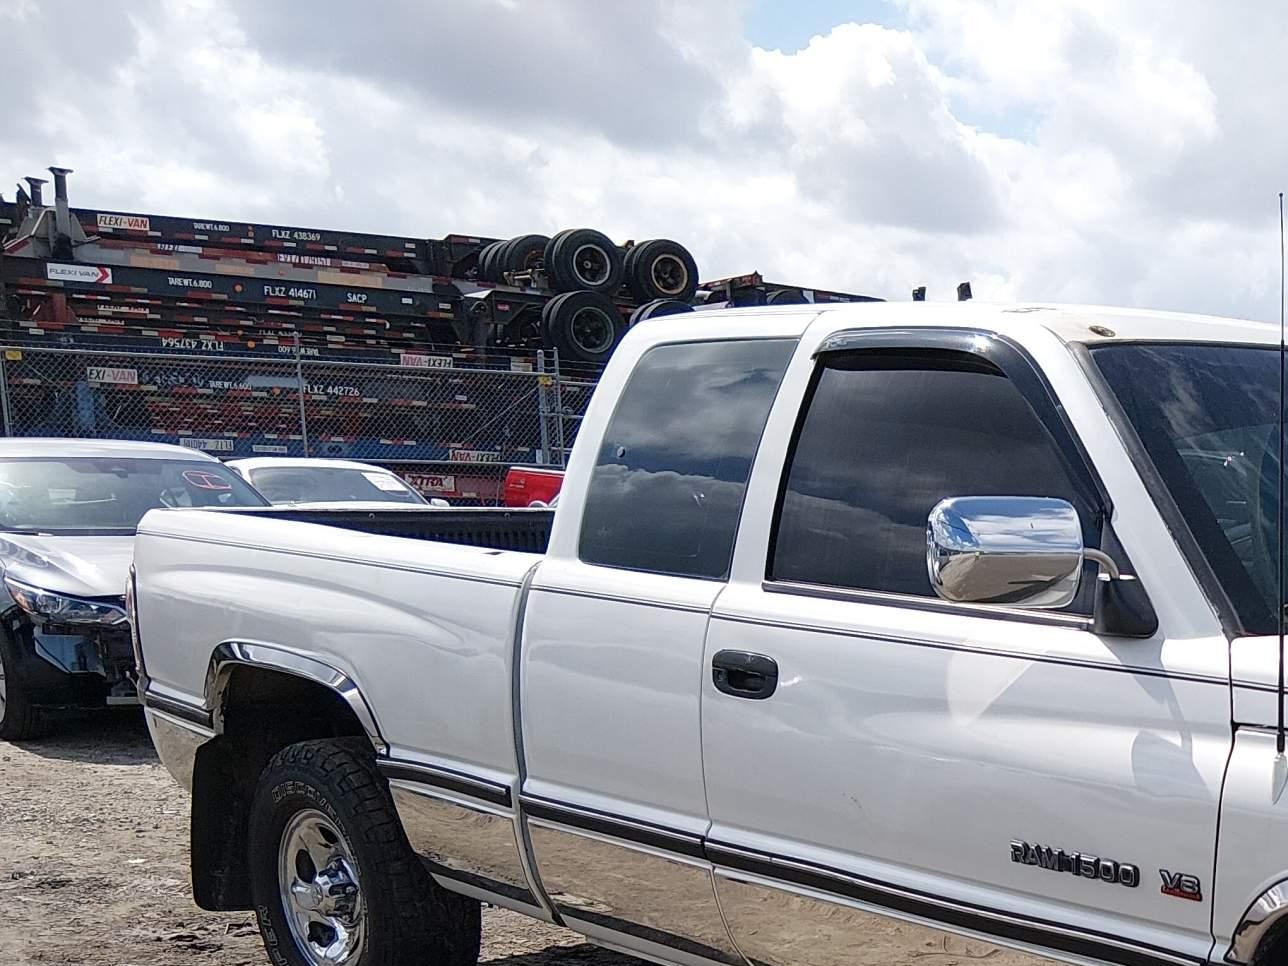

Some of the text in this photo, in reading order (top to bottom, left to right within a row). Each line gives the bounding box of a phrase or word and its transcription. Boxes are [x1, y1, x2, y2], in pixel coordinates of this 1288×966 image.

[98, 214, 148, 229] FLEXI-VAN
[271, 229, 321, 241] FLXZ 438369
[264, 286, 317, 300] FLXZ 414671
[347, 292, 367, 304] SACP
[161, 337, 224, 351] FLXZ 437564
[402, 355, 451, 368] FLEXI-VAN
[303, 384, 360, 397] FLXZ 442726
[1010, 838, 1140, 887] RAM 1500
[1159, 869, 1201, 894] V8
